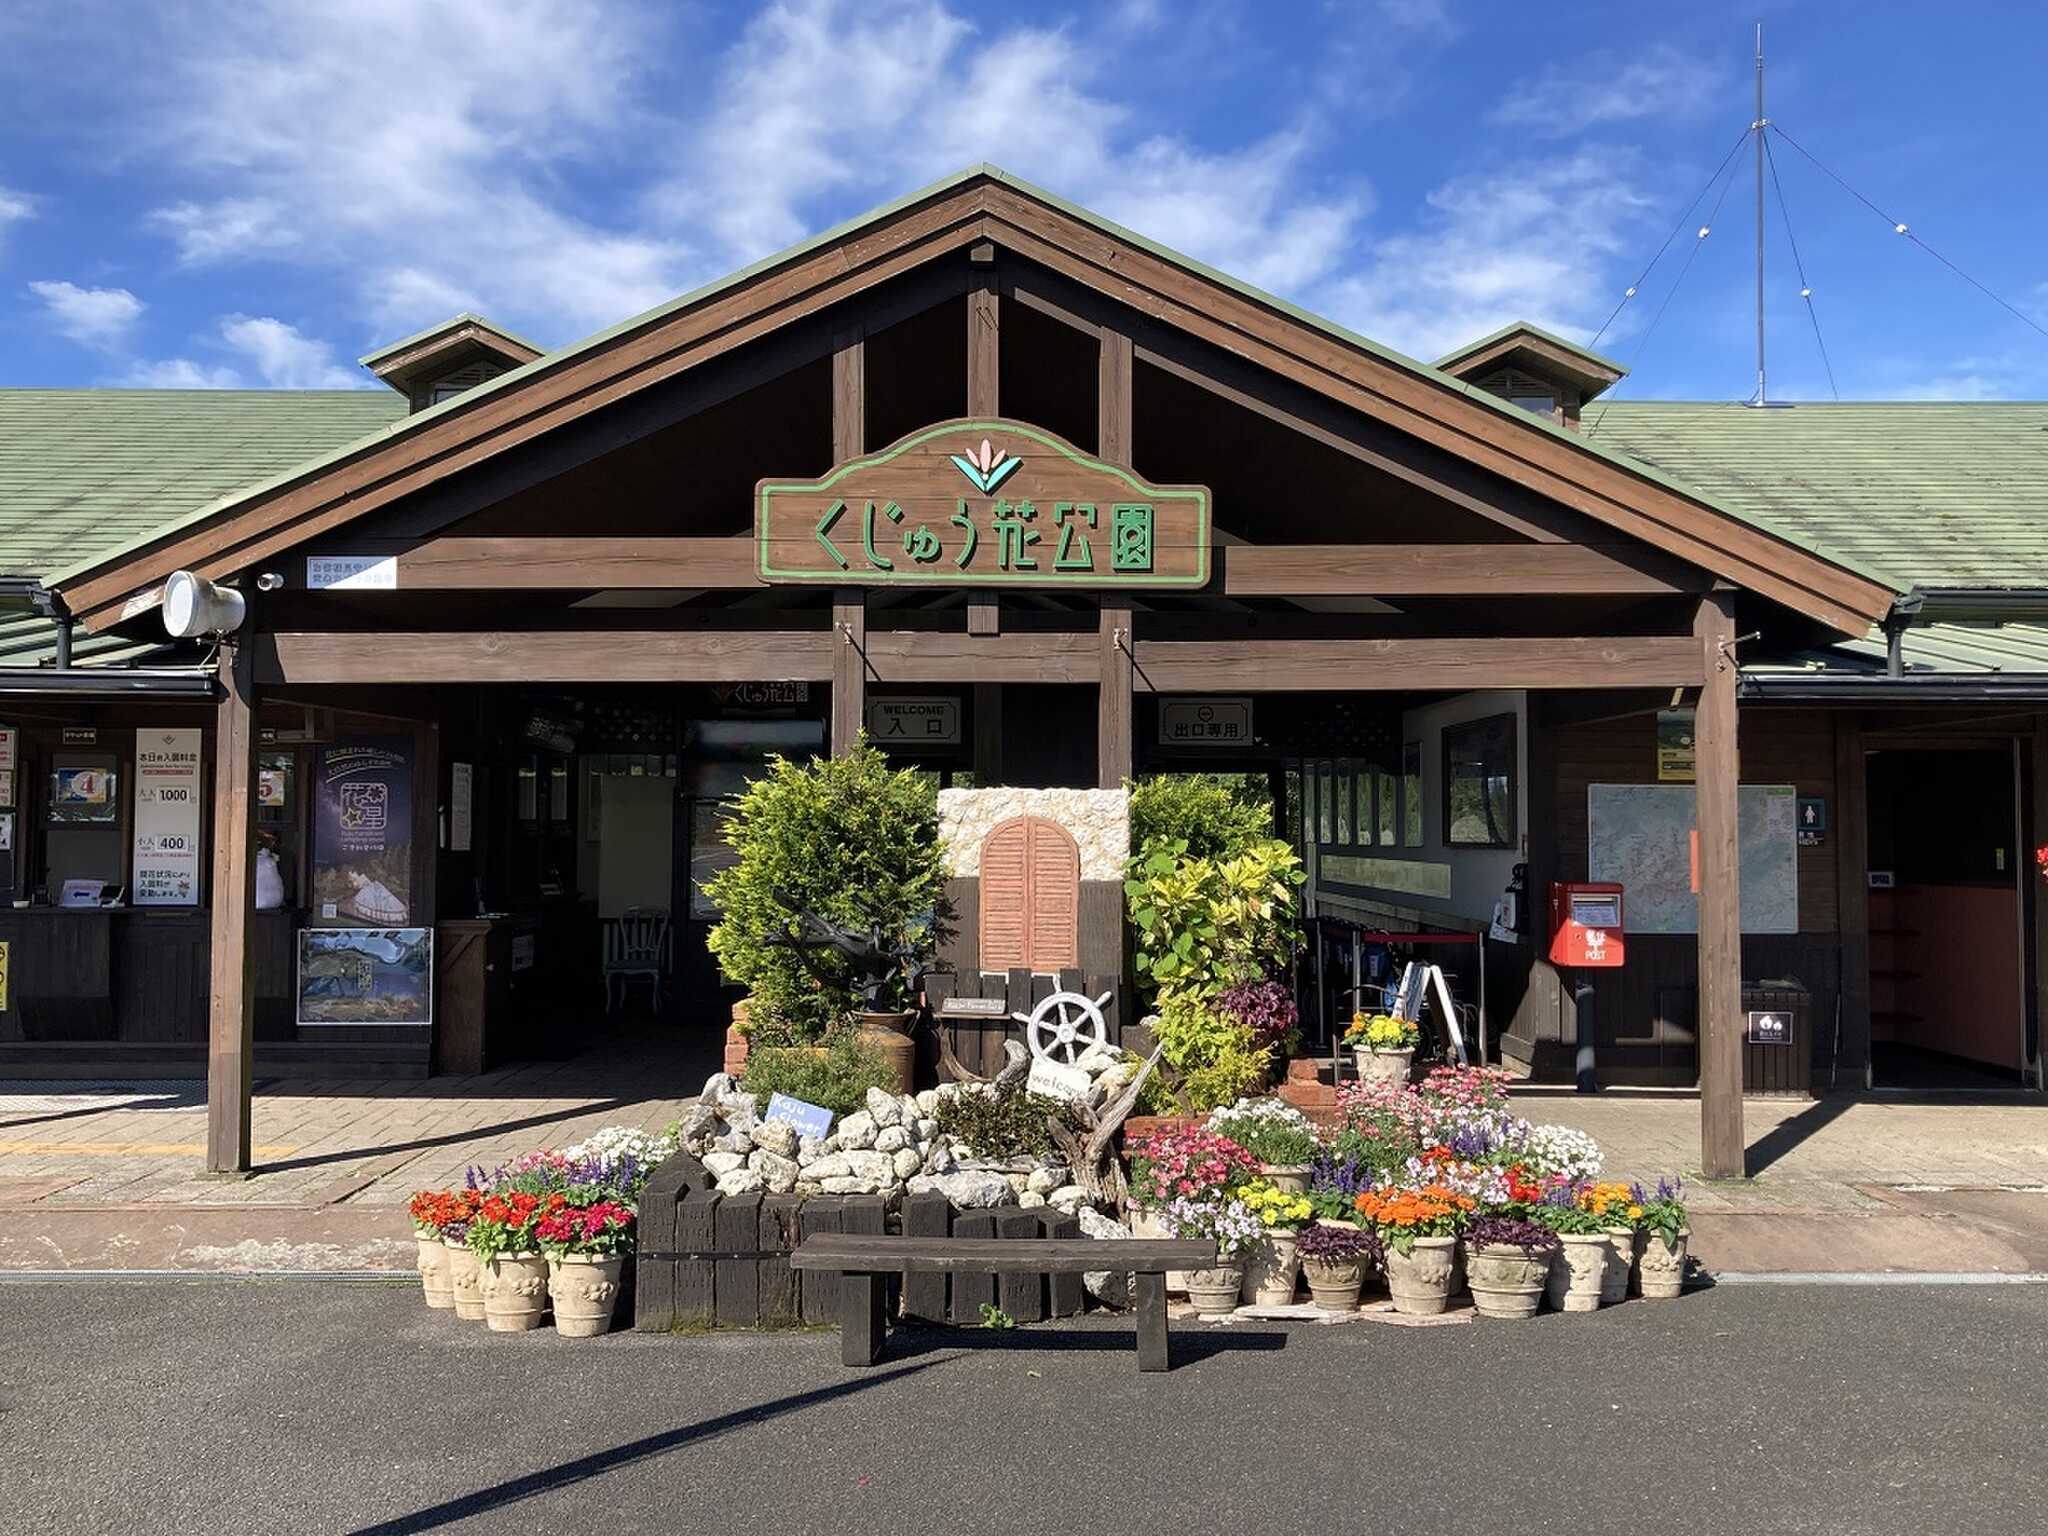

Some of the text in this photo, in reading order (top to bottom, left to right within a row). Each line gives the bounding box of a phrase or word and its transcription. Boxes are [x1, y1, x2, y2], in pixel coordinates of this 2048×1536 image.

[816, 499, 1153, 571] くじゅう花公園
[883, 705, 944, 715] WELCOME
[888, 718, 942, 734] 入口
[1175, 723, 1238, 737] 出口専用
[139, 751, 197, 762] 本日の入園料金
[83, 774, 95, 794] 4
[160, 788, 187, 801] 1000
[160, 837, 184, 849] 400
